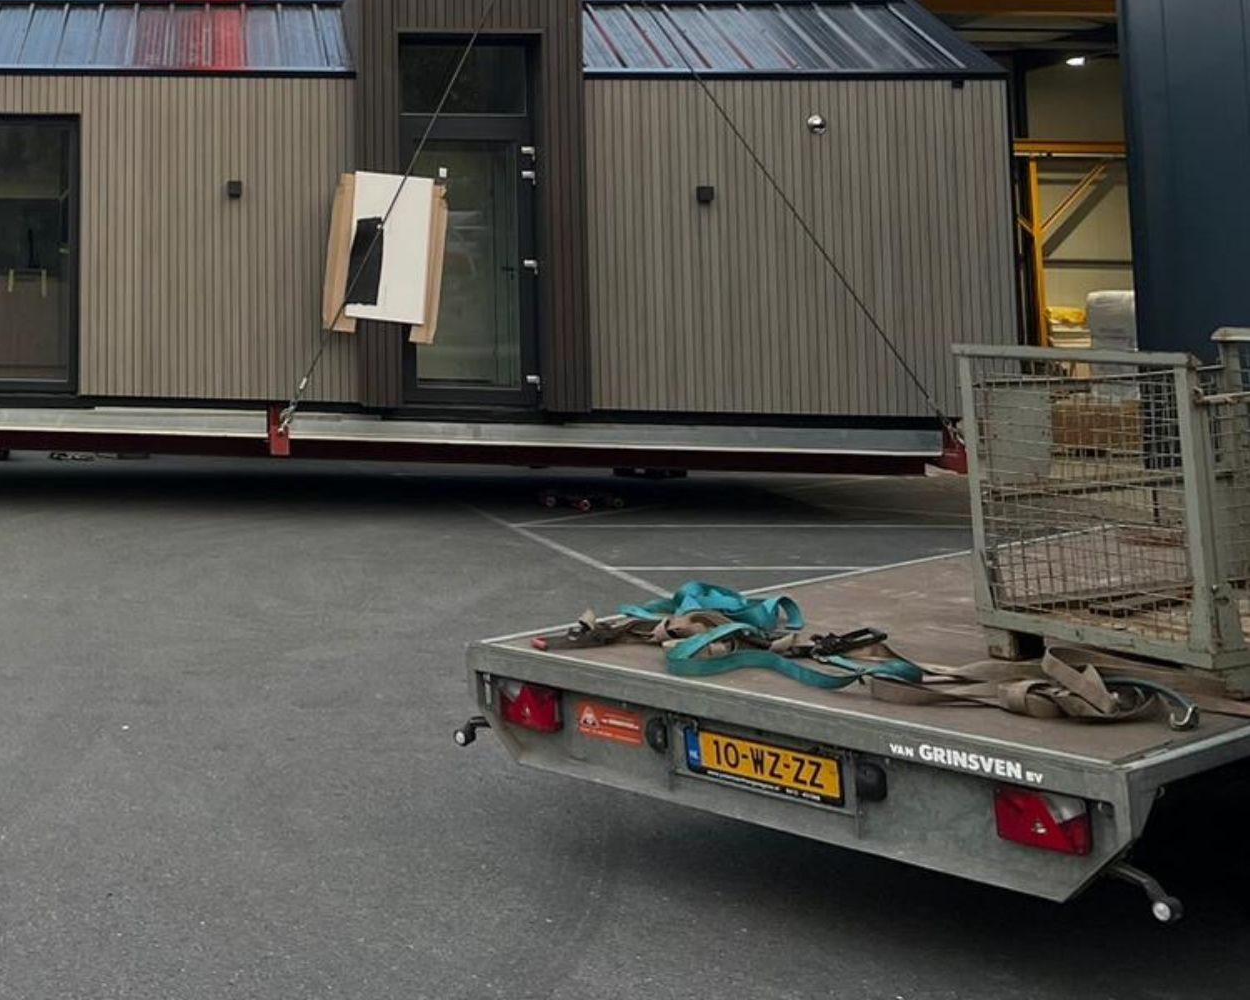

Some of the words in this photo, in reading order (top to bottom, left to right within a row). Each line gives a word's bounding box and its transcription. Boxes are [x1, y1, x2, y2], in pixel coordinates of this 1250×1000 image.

[712, 740, 824, 789] 10-WZ-ZZ
[889, 743, 914, 758] VAN
[918, 744, 1022, 779] GRINSVEN
[1025, 771, 1044, 784] BV
